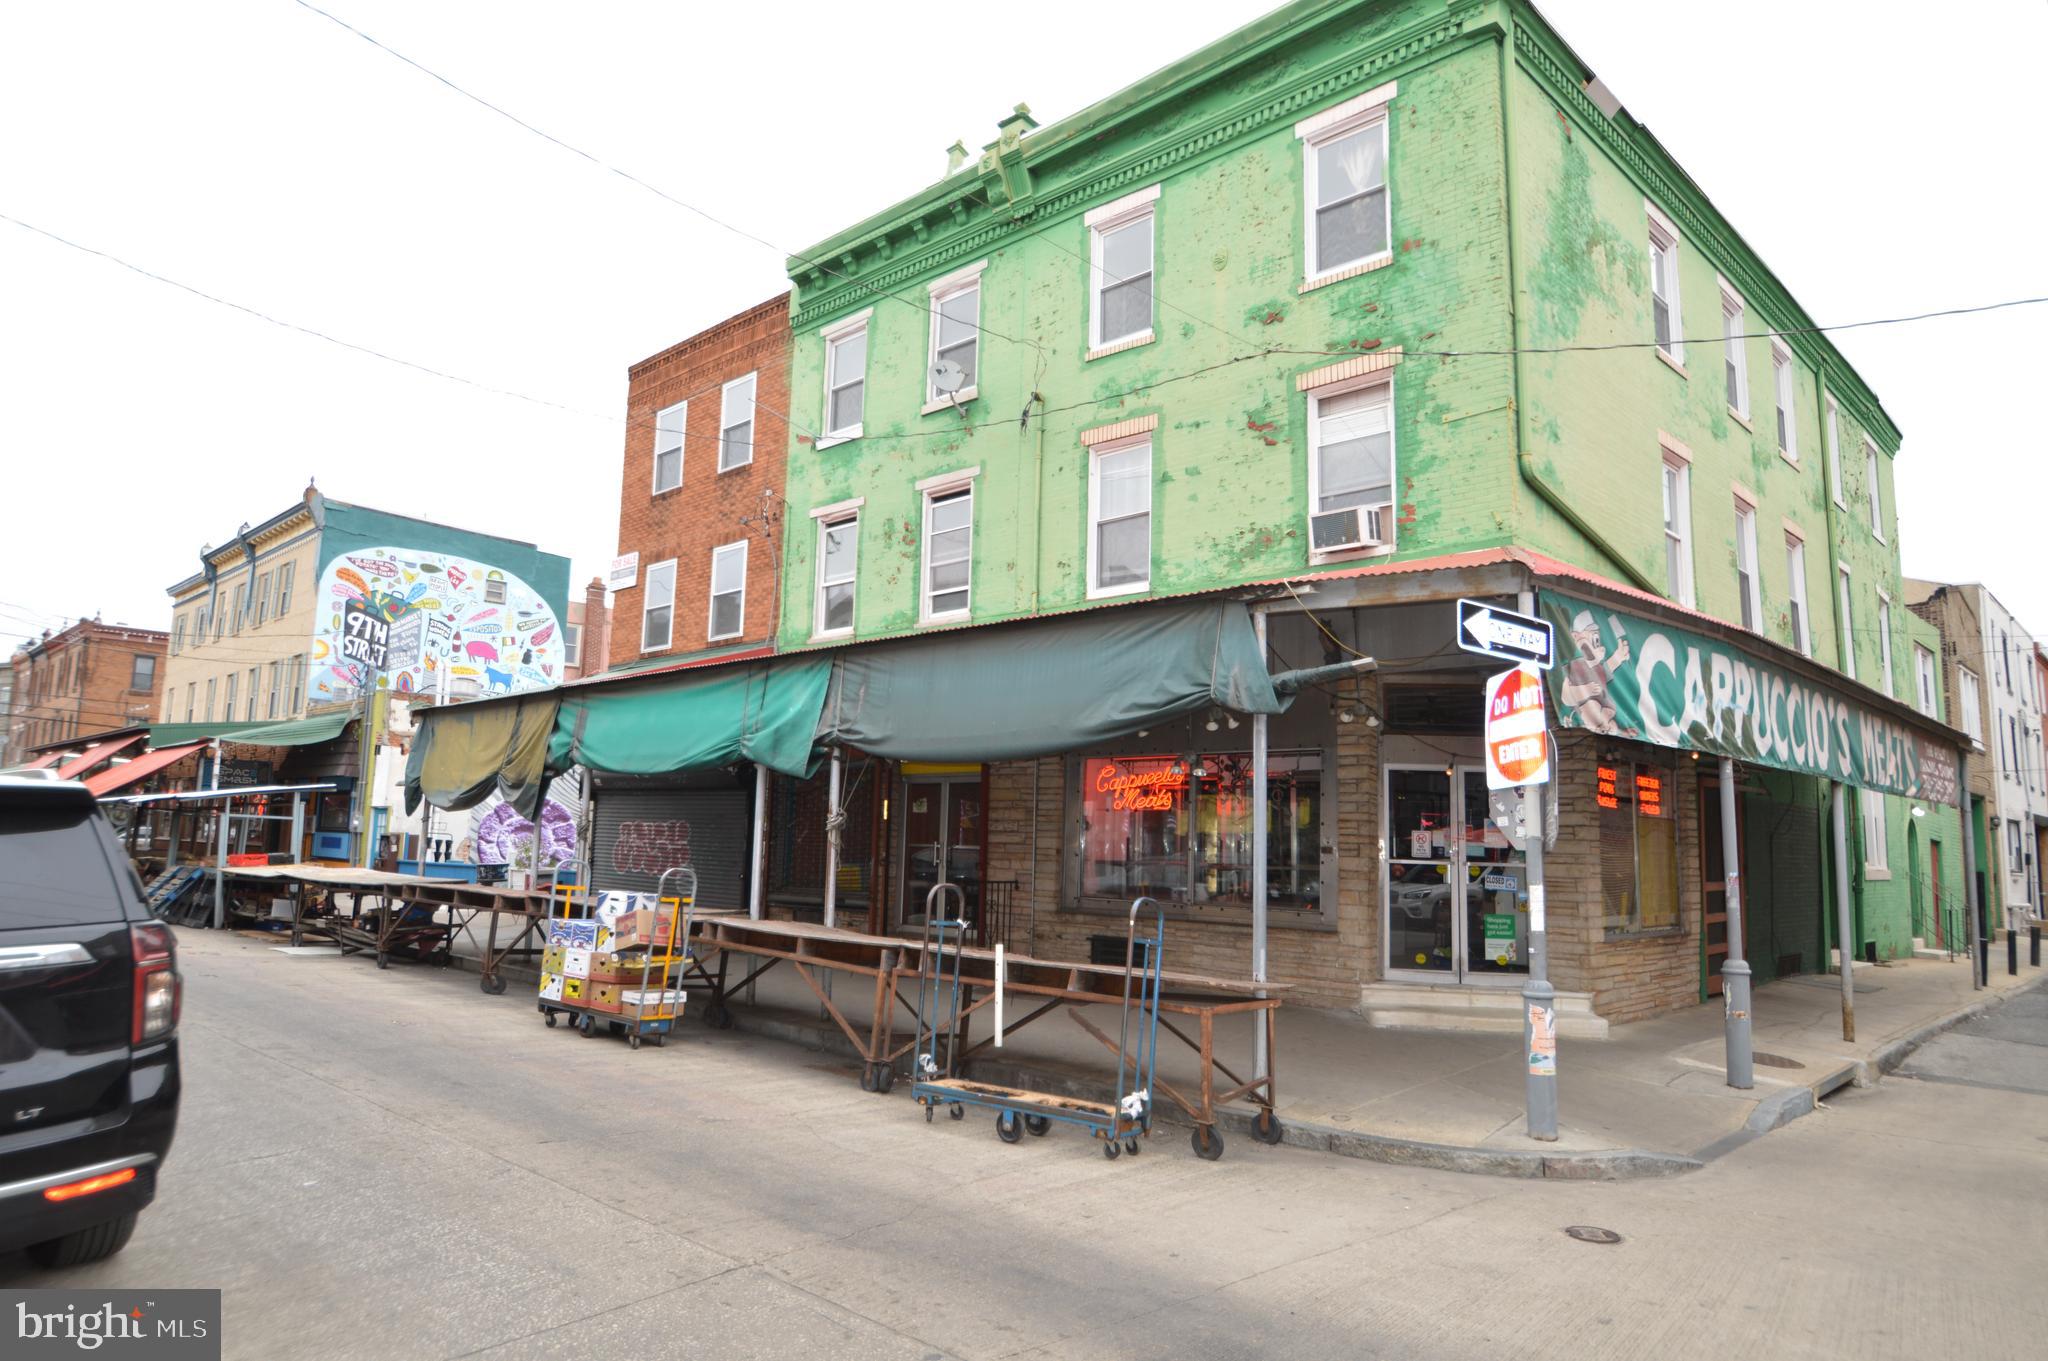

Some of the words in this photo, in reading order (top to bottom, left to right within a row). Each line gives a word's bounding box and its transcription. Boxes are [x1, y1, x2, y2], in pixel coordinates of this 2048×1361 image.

[347, 612, 389, 645] 9TH
[1489, 622, 1514, 643] ONE
[1519, 631, 1543, 649] WAY
[344, 635, 388, 667] STRT
[1494, 696, 1508, 716] DO
[1513, 685, 1541, 710] NOT
[1636, 632, 1854, 777] CAPPUCCIO'S
[1858, 710, 1919, 792] MEATS
[1498, 738, 1541, 765] ENTER
[1113, 786, 1174, 811] Meats
[1486, 876, 1505, 885] CLOSED
[15, 1106, 45, 1121] LT
